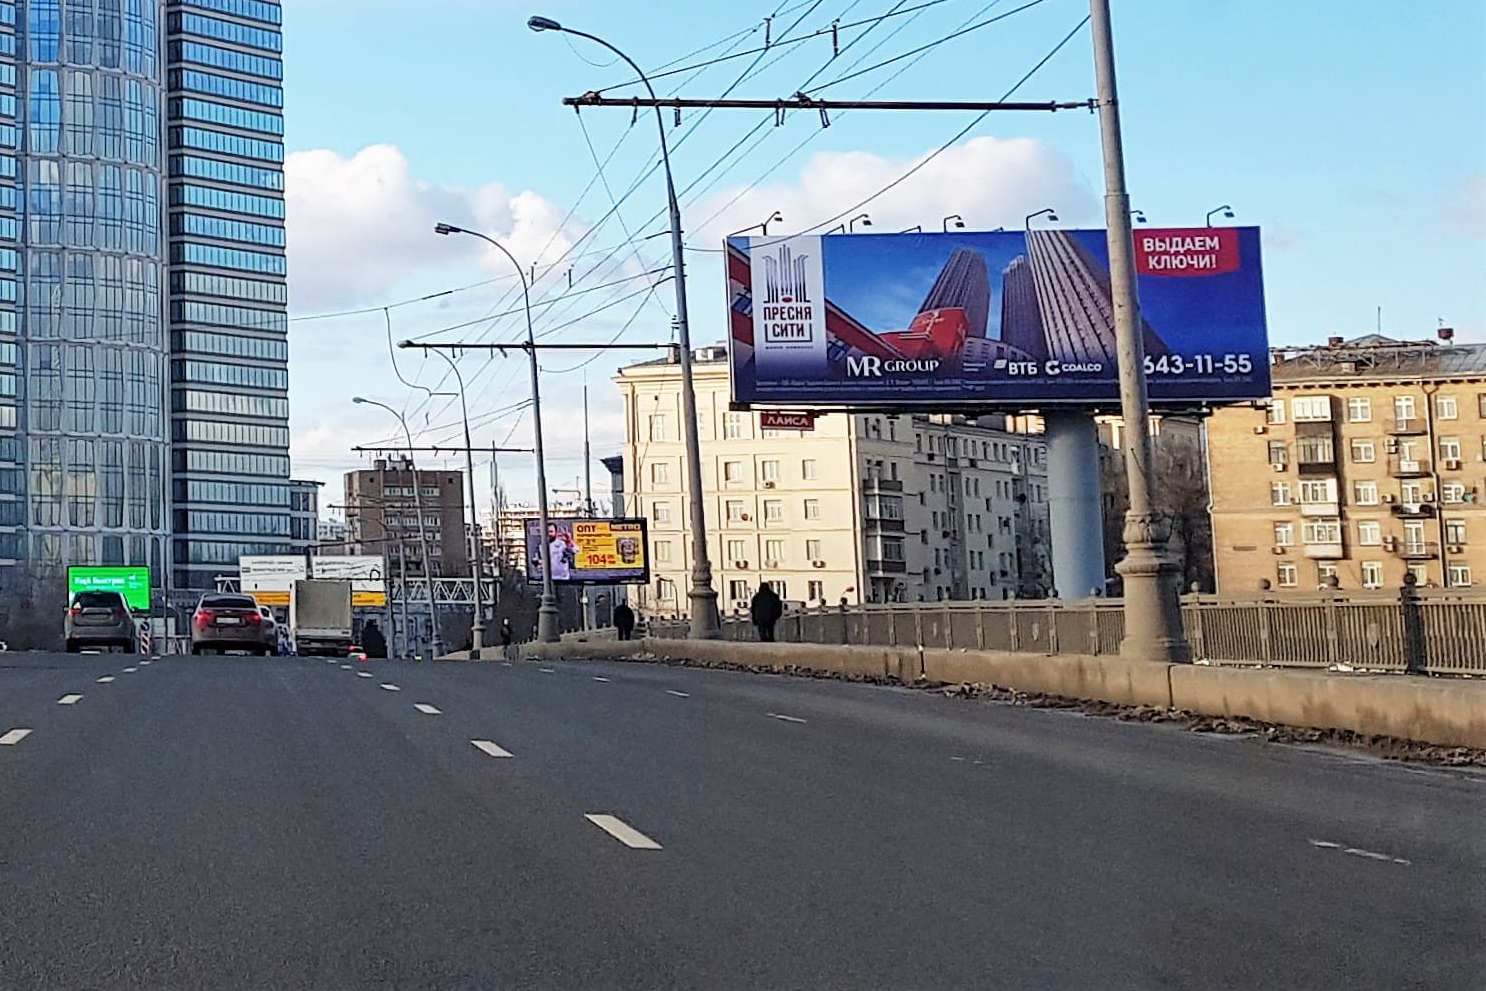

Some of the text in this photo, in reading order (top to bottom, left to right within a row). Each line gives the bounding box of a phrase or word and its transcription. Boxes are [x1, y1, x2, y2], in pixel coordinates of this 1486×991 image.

[1143, 236, 1220, 253] ВЫДАЕМ
[1148, 254, 1217, 269] КЛЮЧИ!
[763, 306, 812, 321] ПРЕСНЯ
[772, 323, 805, 338] СИТИ
[846, 355, 940, 378] MR GROUP
[1008, 362, 1038, 375] ВТБ
[1061, 362, 1102, 372] COALCO
